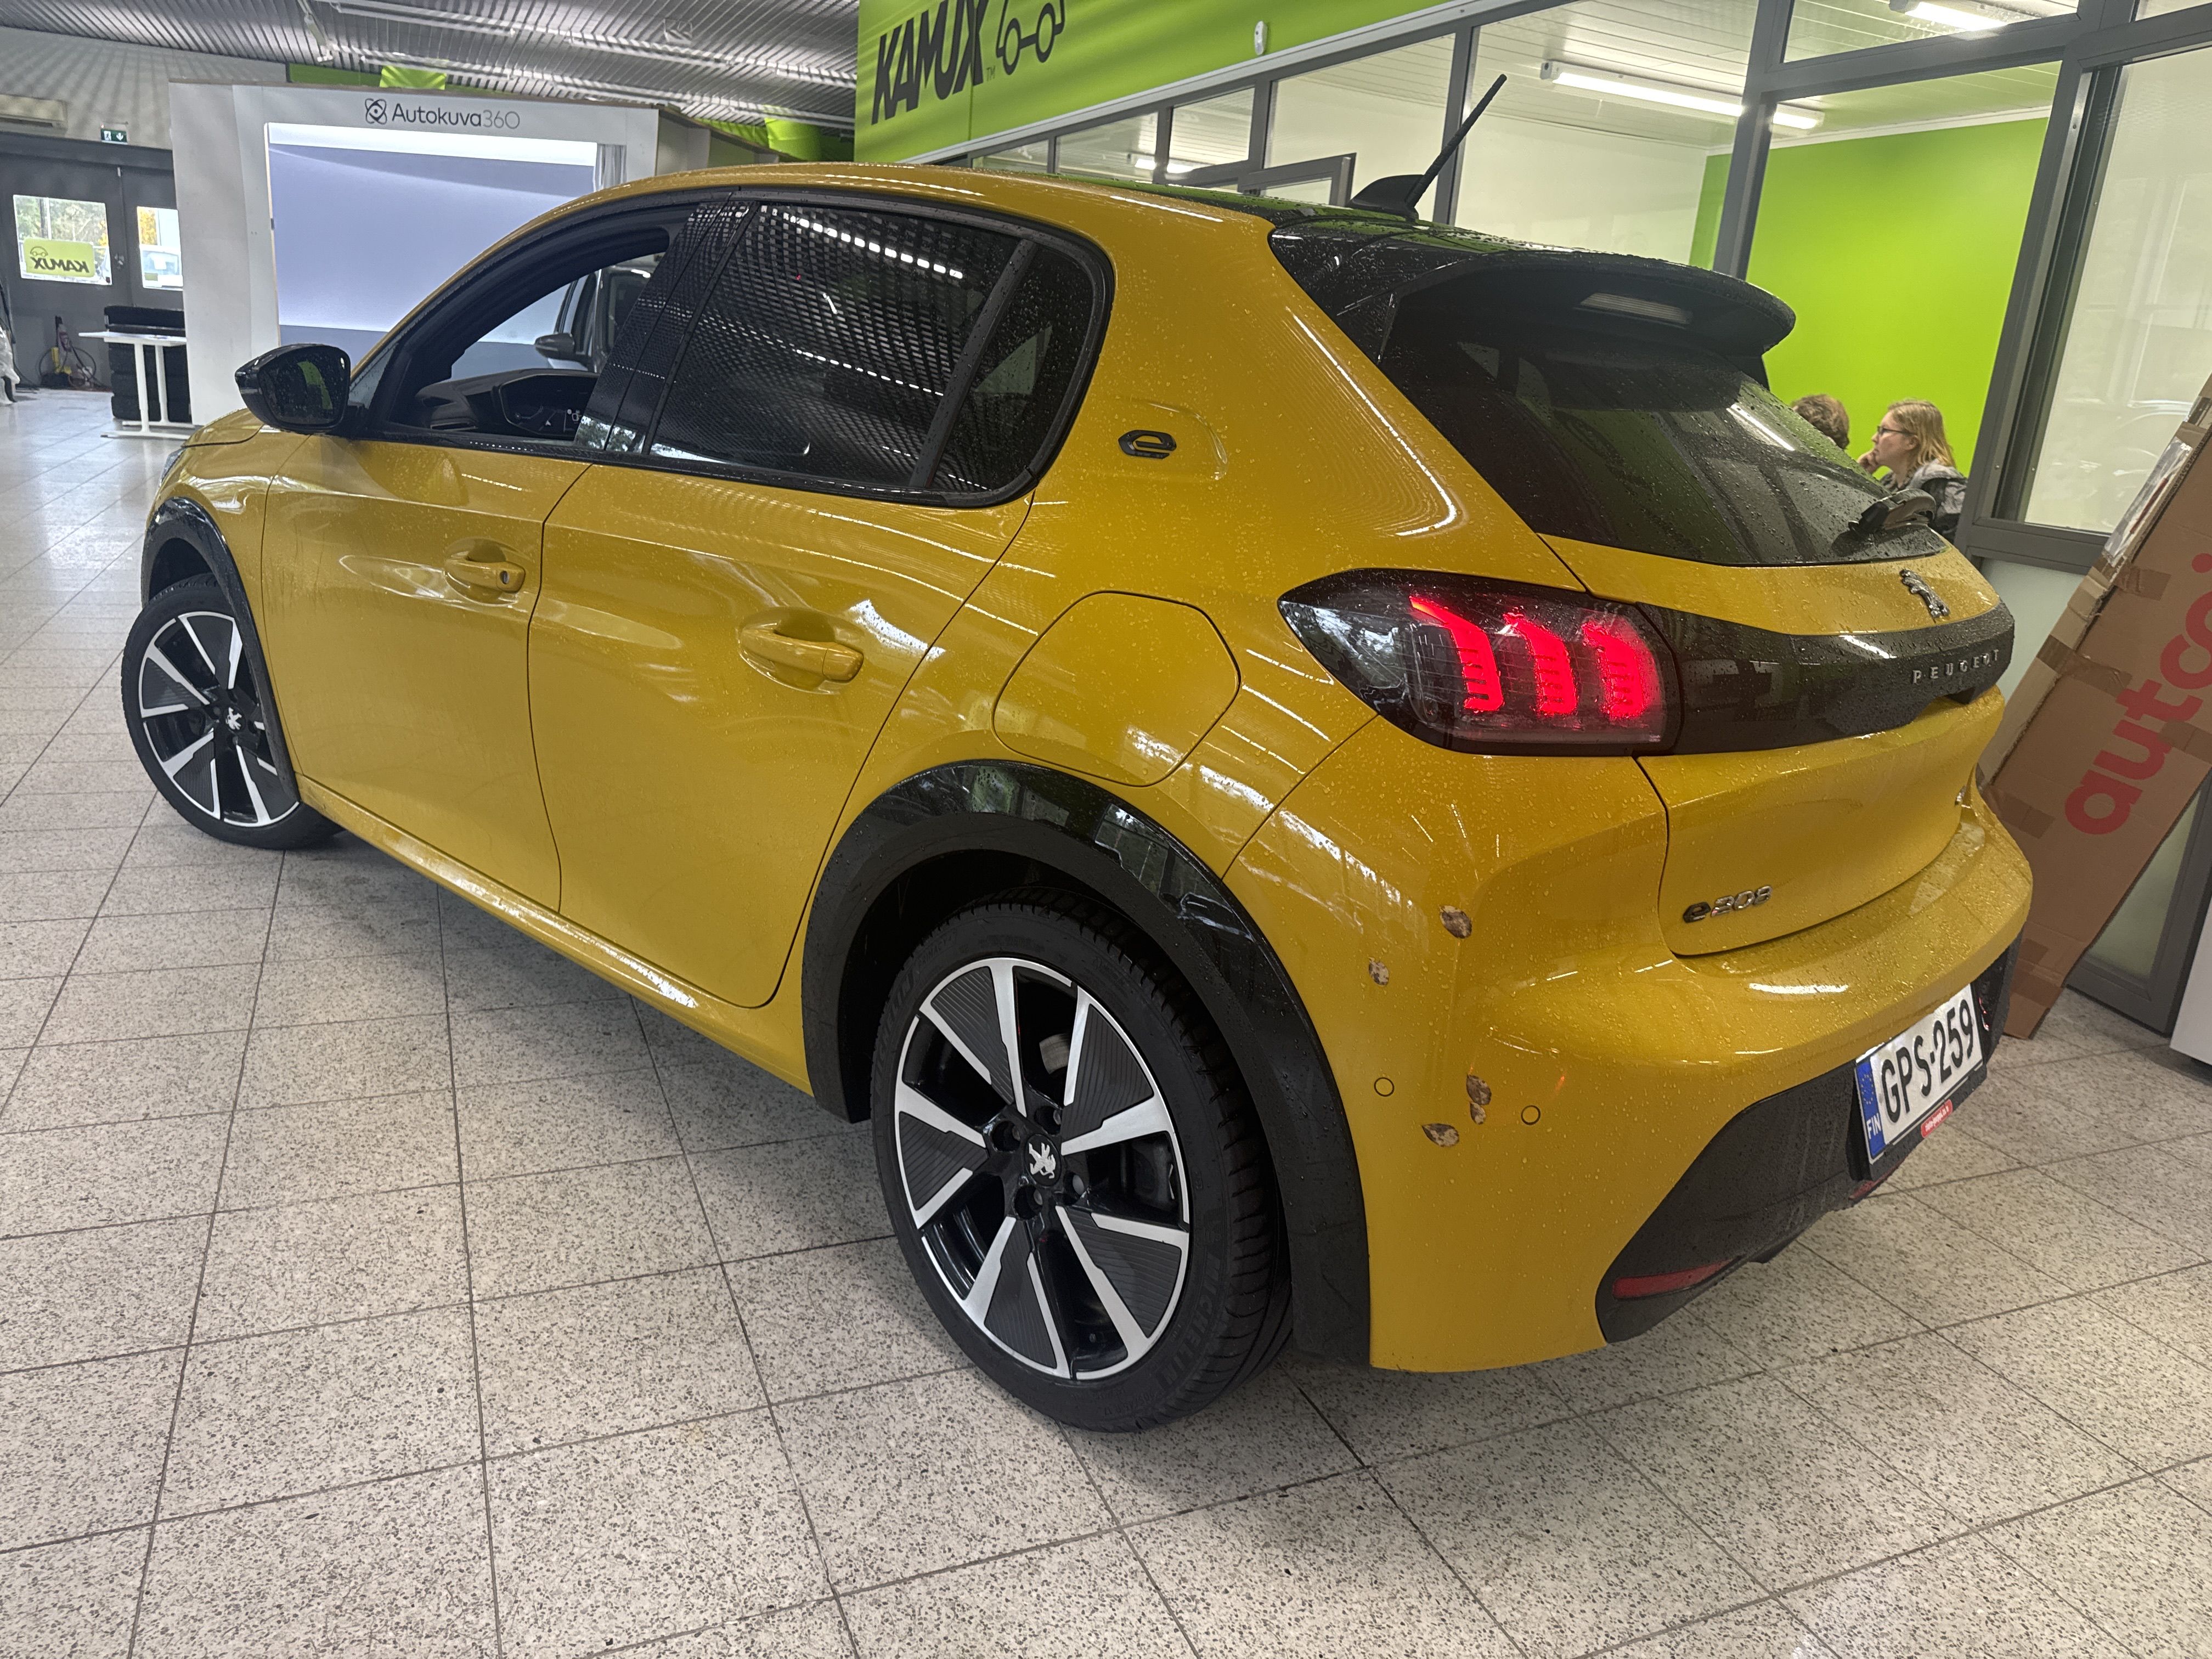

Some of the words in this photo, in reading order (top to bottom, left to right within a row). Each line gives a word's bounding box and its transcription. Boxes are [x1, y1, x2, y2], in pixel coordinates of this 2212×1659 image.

[871, 0, 989, 126] KAMUX
[392, 103, 520, 129] Autokuva360
[1912, 649, 2000, 685] PEUGEOT
[1881, 998, 1974, 1124] GPS-259
[1866, 1113, 1881, 1140] FIN
[1155, 1245, 1221, 1387] MICHELIN
